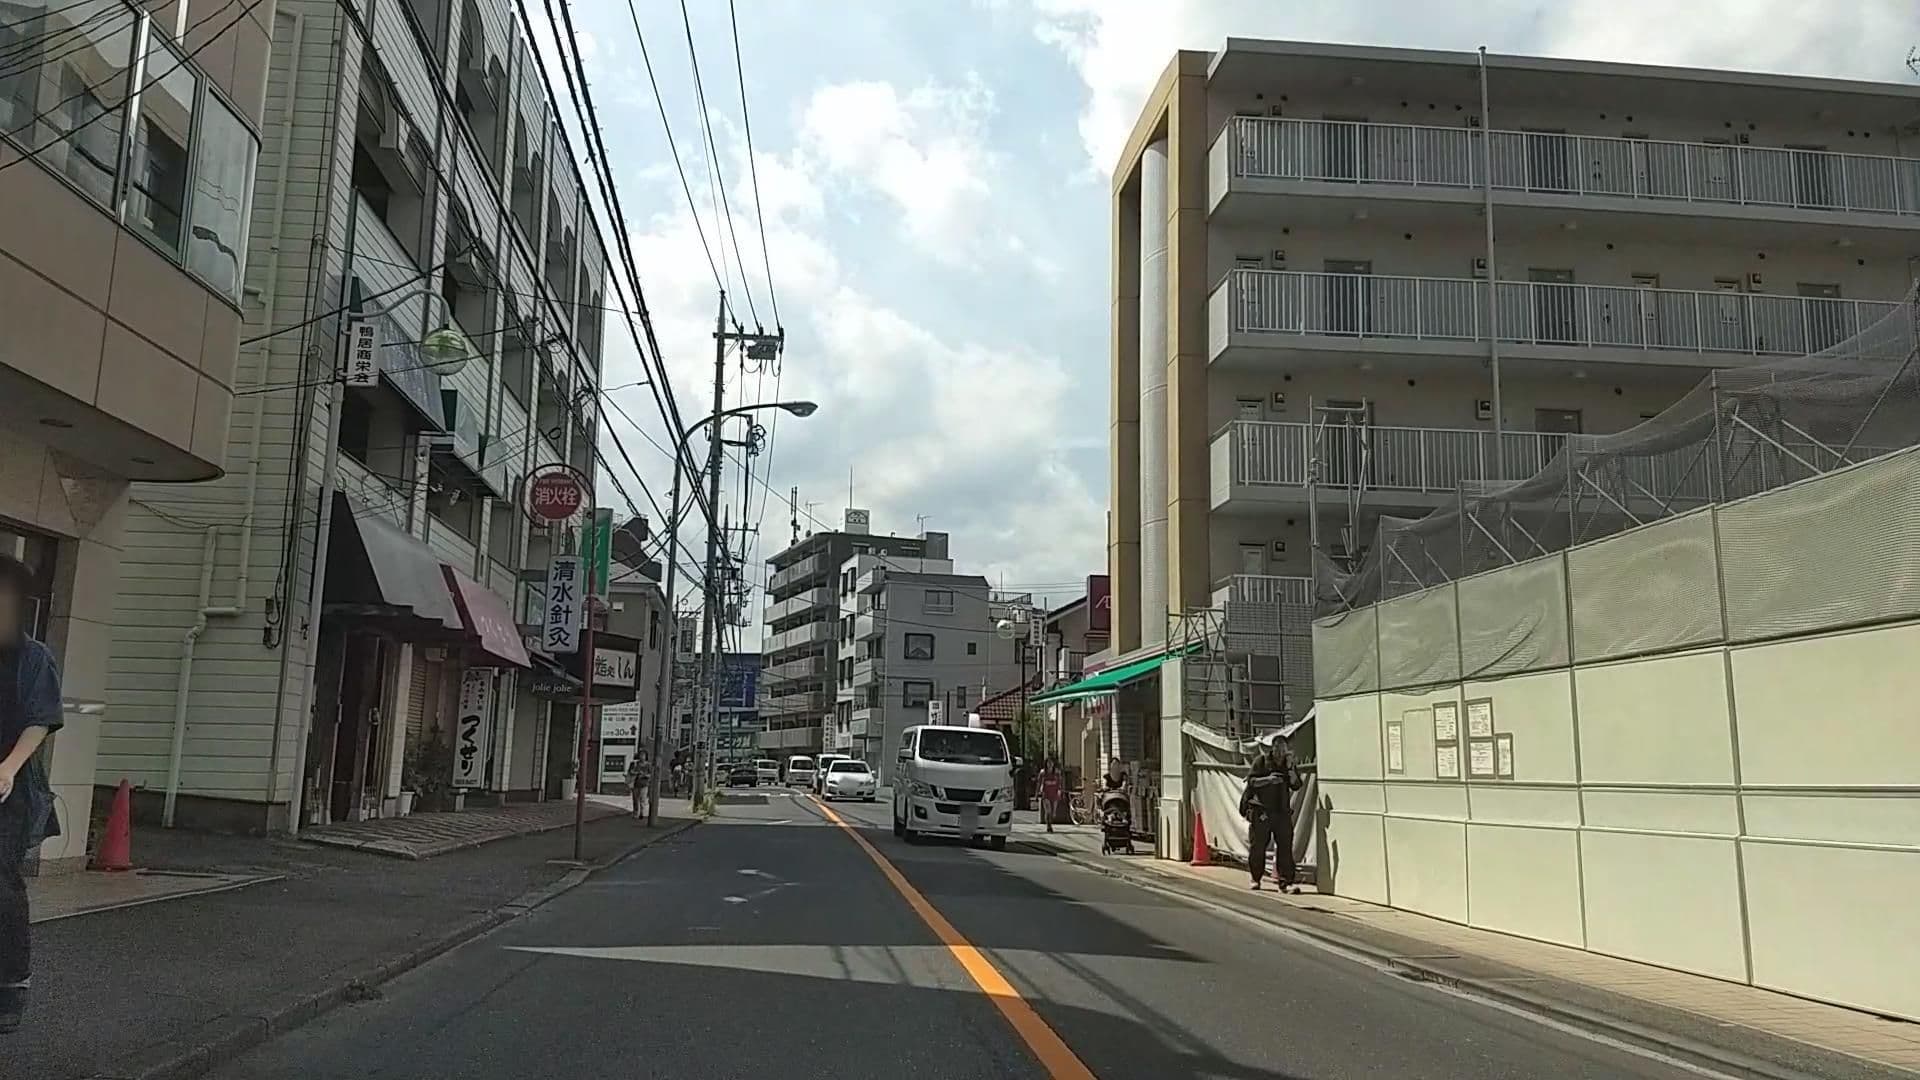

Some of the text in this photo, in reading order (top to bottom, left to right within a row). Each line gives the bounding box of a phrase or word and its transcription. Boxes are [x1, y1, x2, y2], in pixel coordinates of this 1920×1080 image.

[354, 326, 374, 383] 鴨居商栄会
[535, 487, 578, 507] 消火栓
[548, 560, 577, 647] 清水針灸
